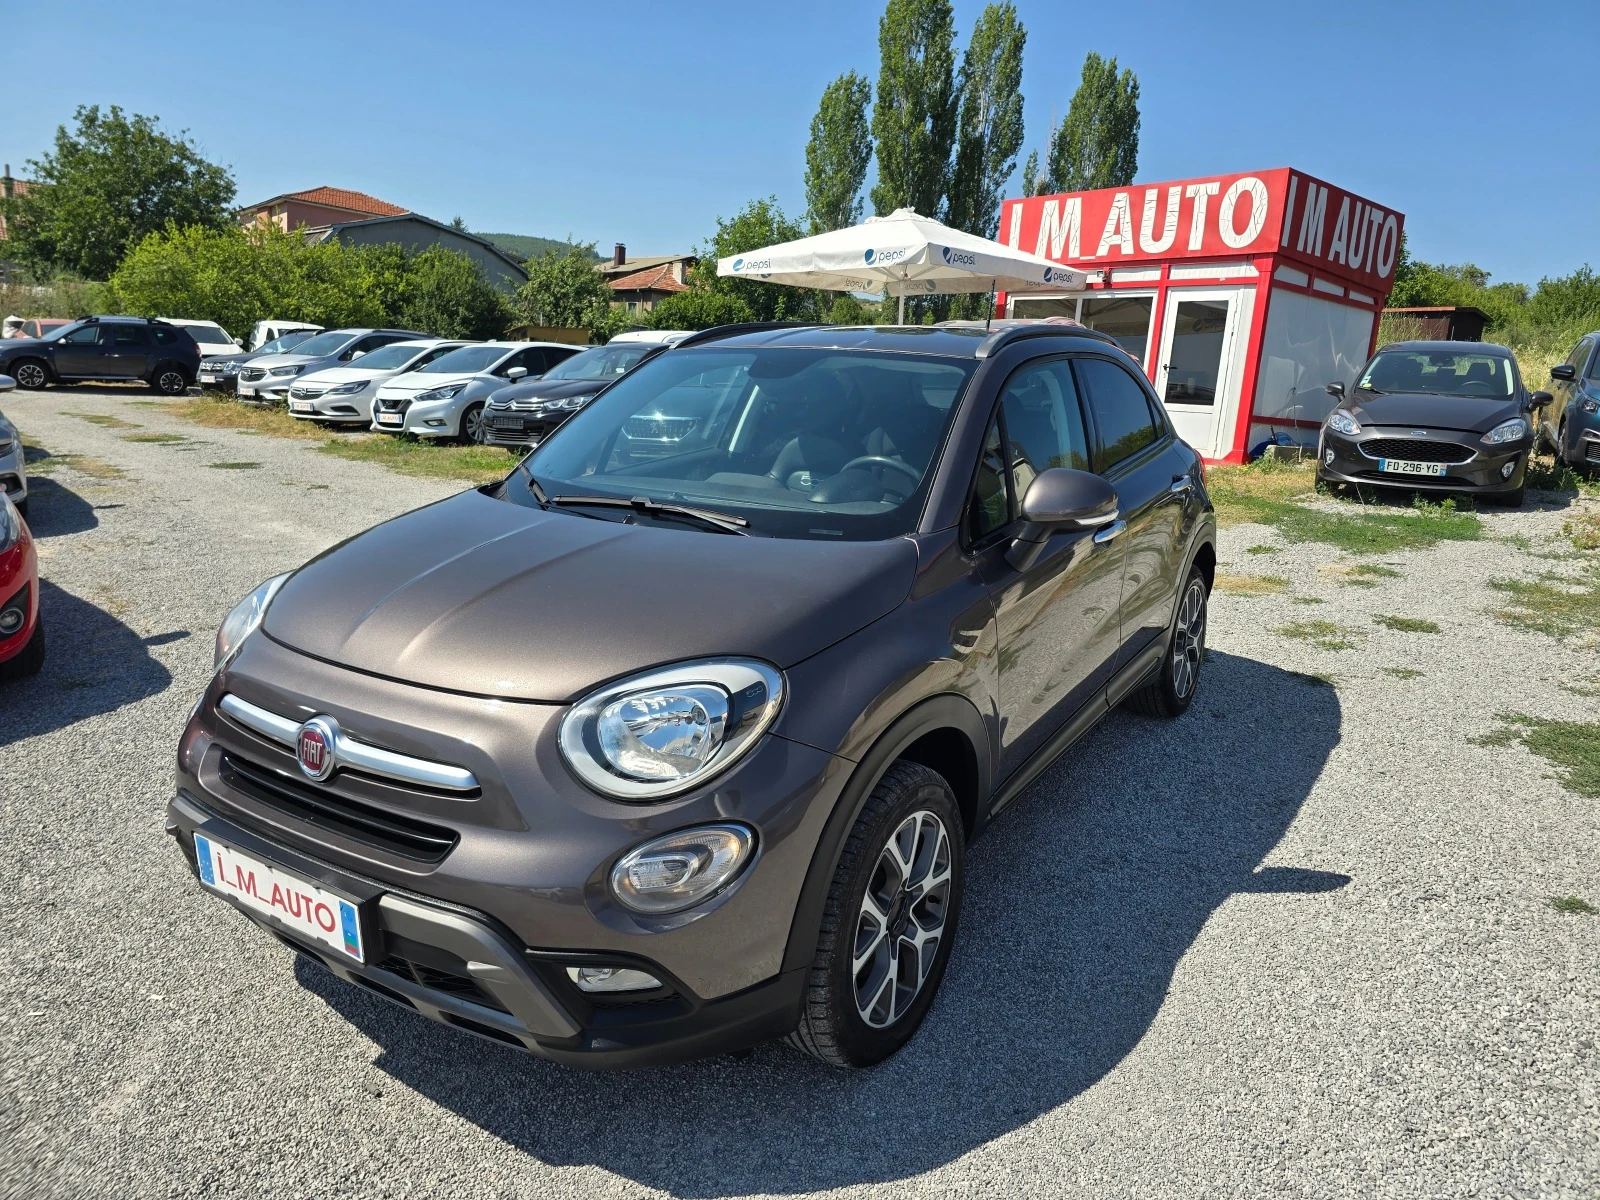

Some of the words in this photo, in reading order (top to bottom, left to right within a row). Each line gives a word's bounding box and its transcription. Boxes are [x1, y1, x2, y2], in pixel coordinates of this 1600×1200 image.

[1008, 203, 1023, 250] I
[1281, 175, 1298, 247] I
[1297, 182, 1328, 257] M
[1328, 196, 1398, 279] AUTO
[878, 248, 906, 263] pepsi
[952, 254, 976, 266] pepsi
[746, 258, 771, 271] pepsi
[1053, 272, 1074, 284] pepsi
[303, 738, 323, 765] FIAT
